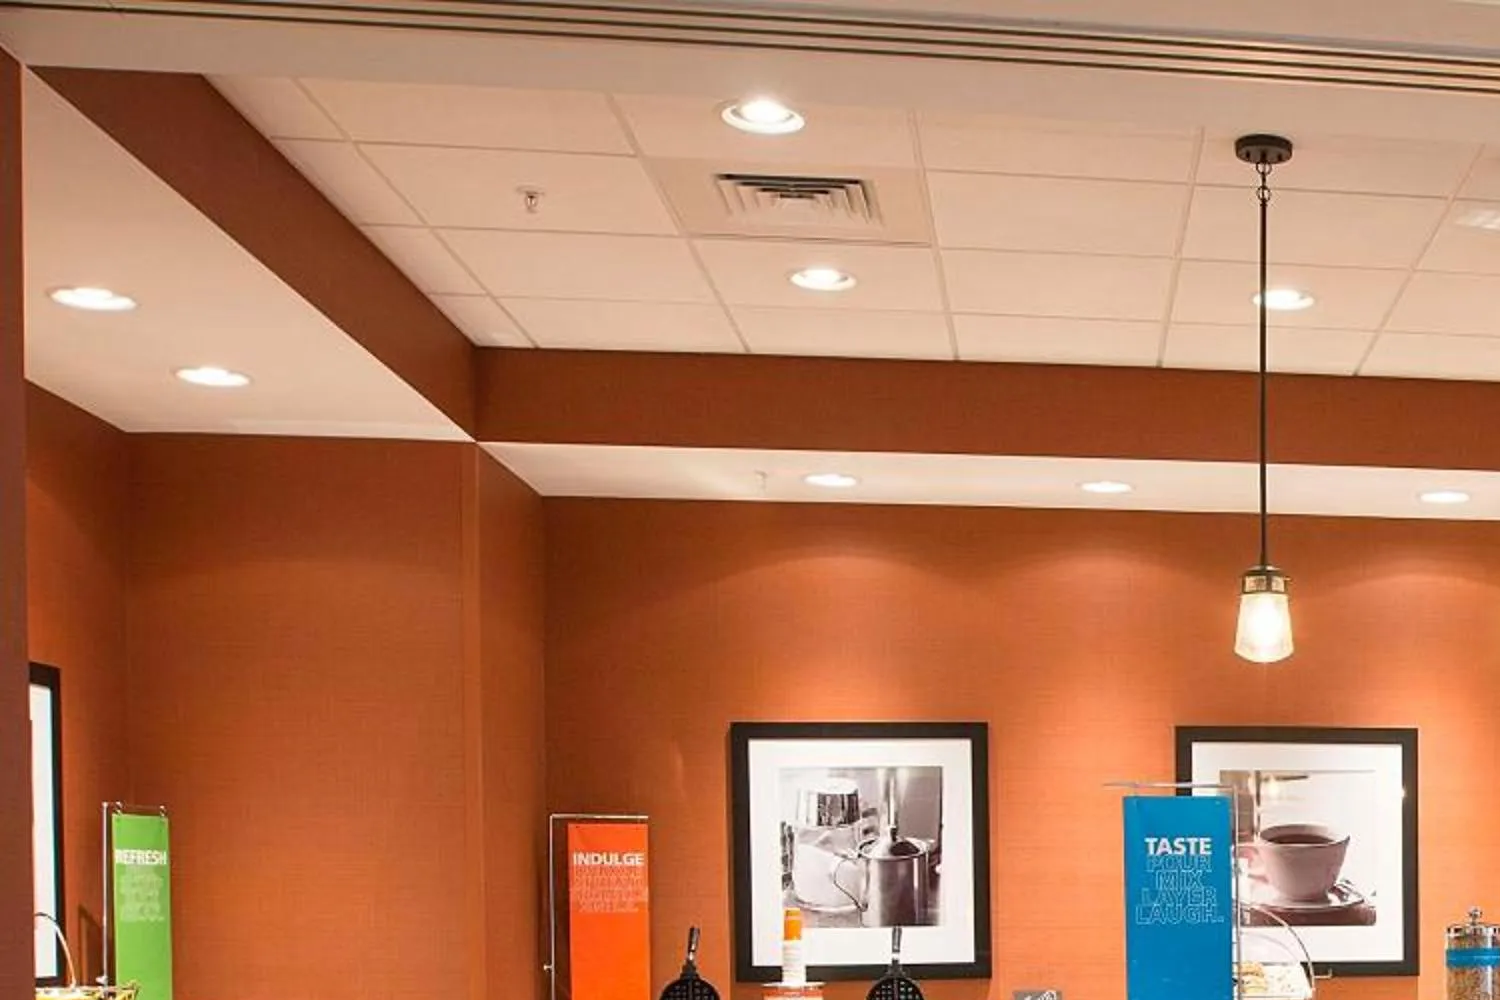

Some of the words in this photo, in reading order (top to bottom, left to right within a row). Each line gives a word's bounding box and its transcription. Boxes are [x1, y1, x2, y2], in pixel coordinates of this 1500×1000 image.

[1144, 837, 1212, 855] TASTE
[573, 852, 644, 866] INDULGE
[1145, 855, 1212, 872] POUR
[1155, 869, 1204, 889] MIX
[1141, 886, 1217, 906] LAYER
[1135, 904, 1225, 925] LAUGH.
